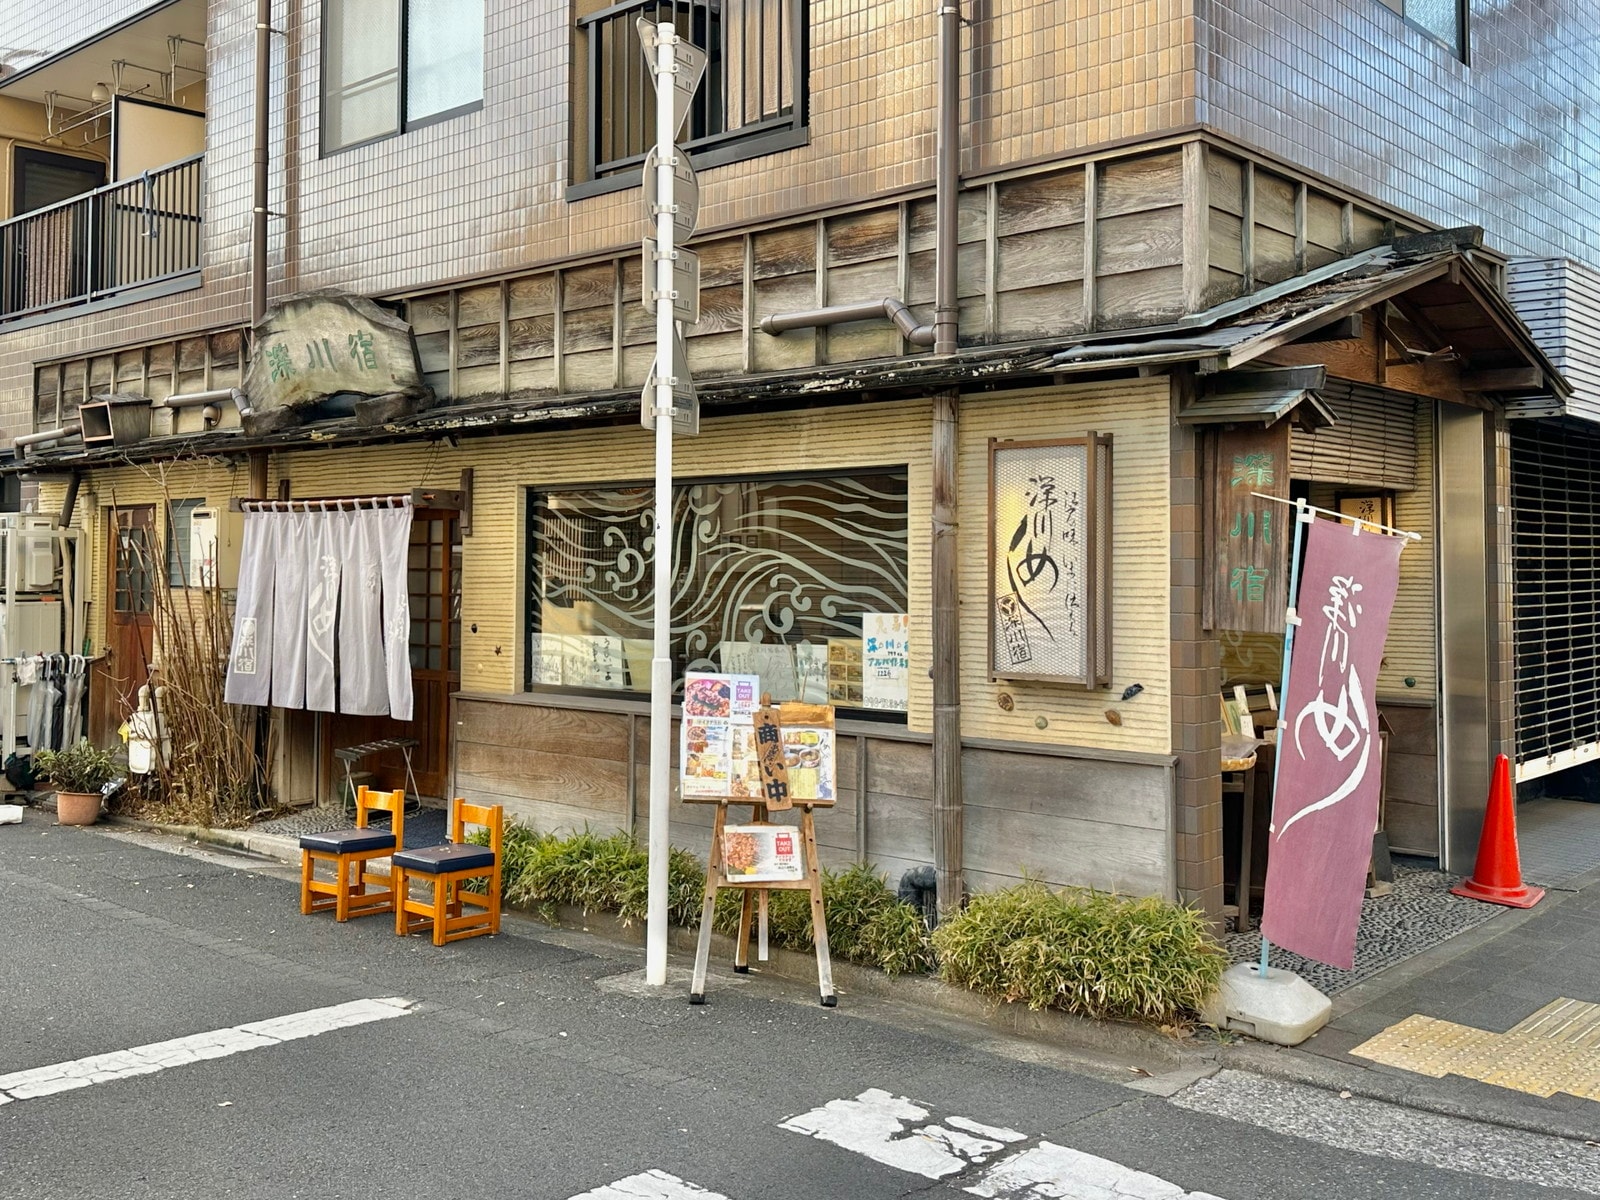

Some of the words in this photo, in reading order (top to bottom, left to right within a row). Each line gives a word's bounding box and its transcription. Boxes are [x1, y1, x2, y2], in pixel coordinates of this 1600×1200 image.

[265, 329, 378, 383] 深川宿
[1007, 474, 1059, 642] 深川めし
[1229, 453, 1275, 602] 深川宿
[238, 635, 254, 672] 深川宿
[1004, 614, 1027, 661] 深川宿
[758, 722, 788, 803] 商い中
